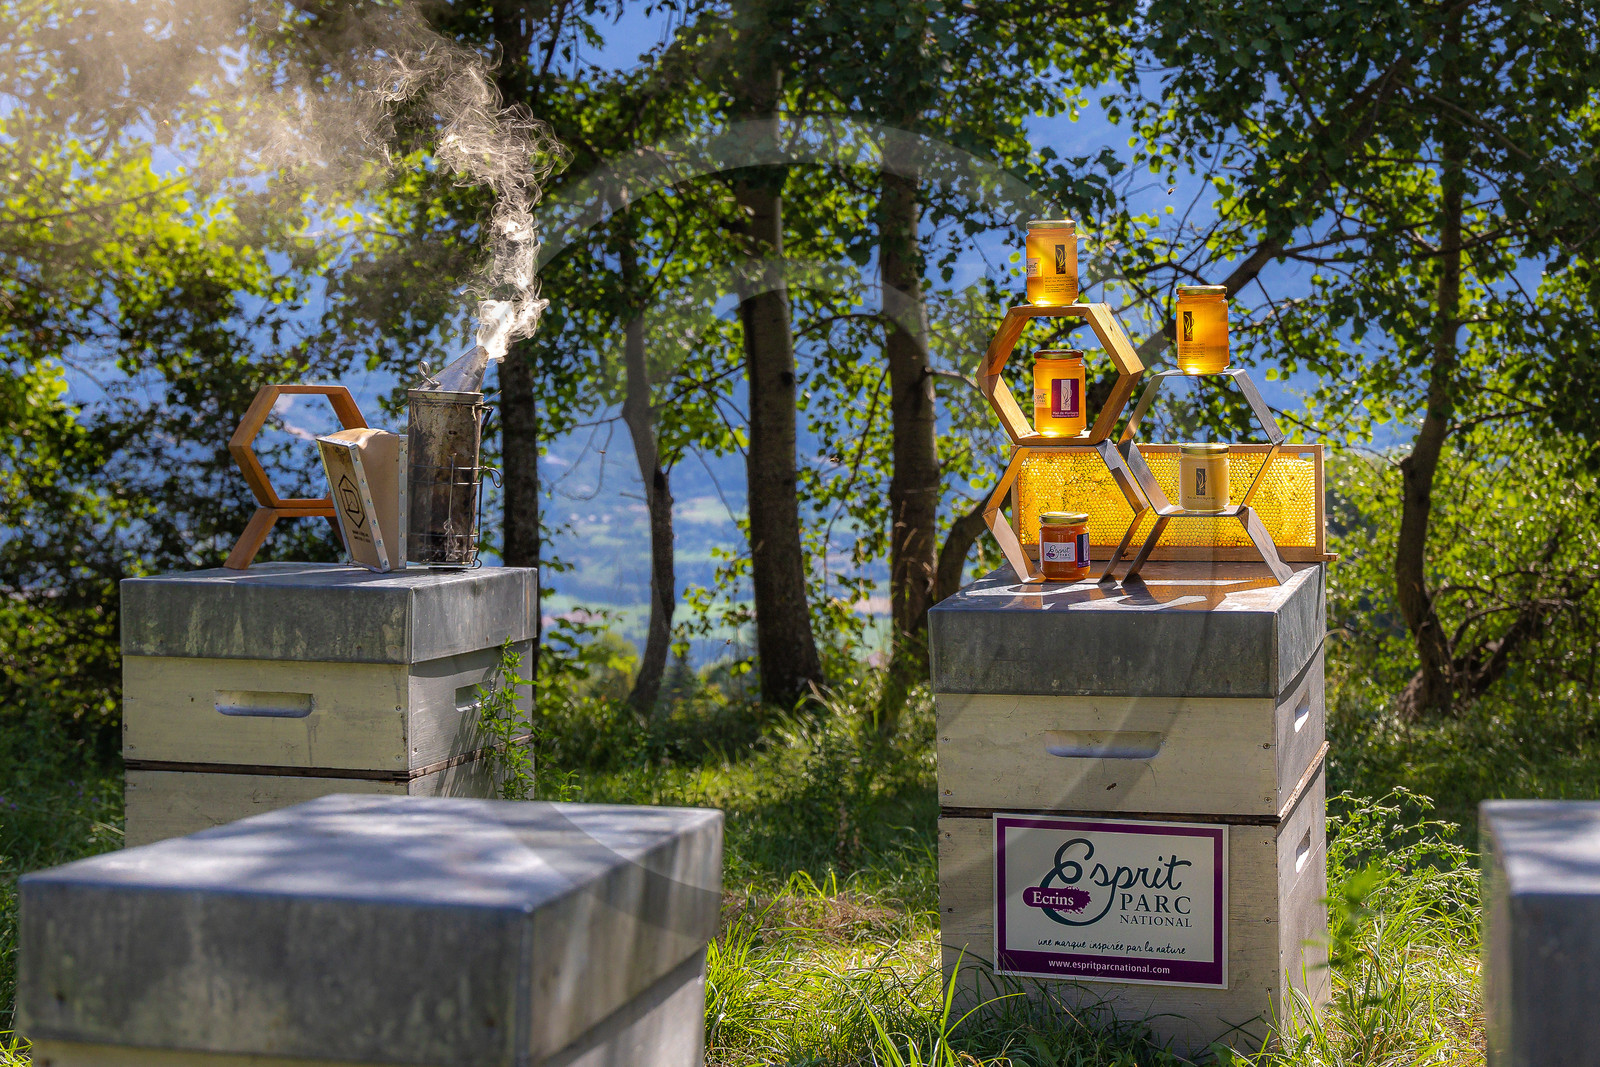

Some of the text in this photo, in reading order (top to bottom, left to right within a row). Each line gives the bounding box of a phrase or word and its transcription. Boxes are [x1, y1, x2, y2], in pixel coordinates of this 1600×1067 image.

[1039, 838, 1192, 927] Esprit
[1032, 891, 1074, 906] Ecrins
[1119, 892, 1191, 915] PARC
[1119, 914, 1193, 928] NATIONAL
[1054, 939, 1086, 950] marque
[1089, 939, 1124, 952] inspirée
[1126, 943, 1143, 954] par
[1144, 942, 1154, 953] la
[1156, 945, 1186, 955] nature
[1048, 959, 1170, 975] www.espritparcnational.com
